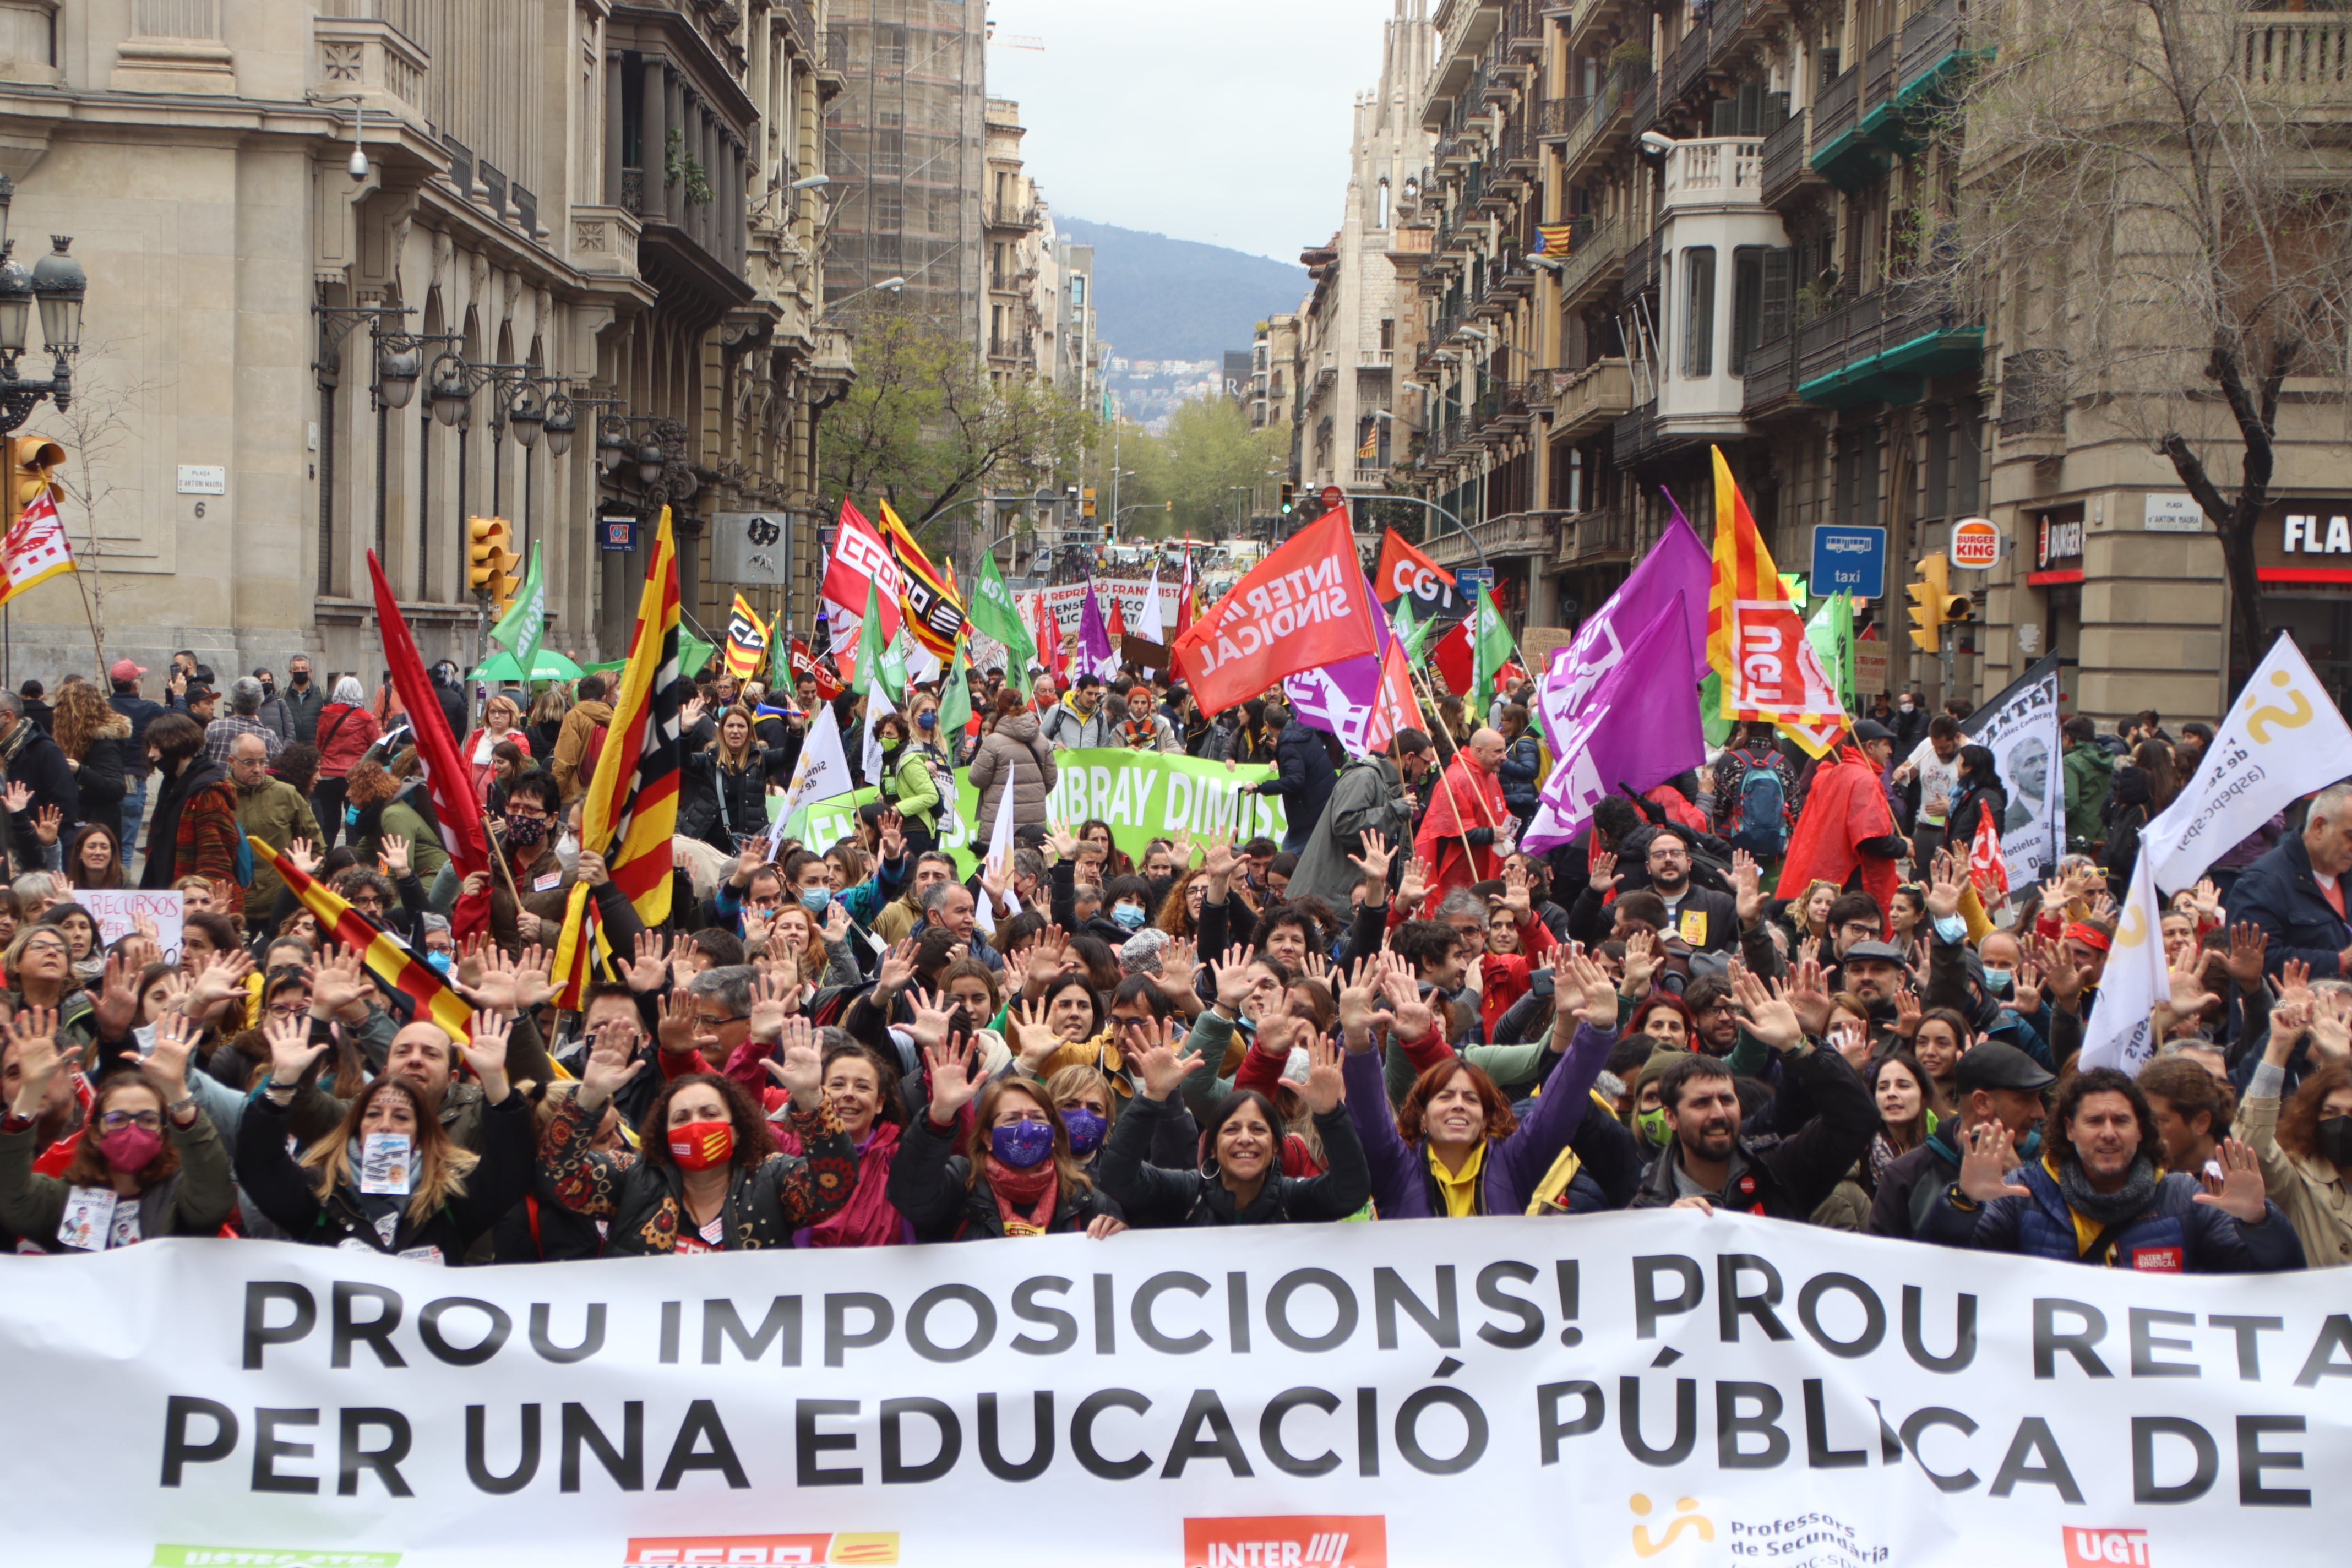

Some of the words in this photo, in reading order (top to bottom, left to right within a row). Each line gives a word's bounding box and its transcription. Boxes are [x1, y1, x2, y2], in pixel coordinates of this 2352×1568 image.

[194, 501, 206, 518] 6
[1957, 535, 1995, 544] BURGER
[2050, 521, 2082, 558] BURGER
[2284, 515, 2352, 553] FLA
[1956, 544, 1995, 557] KING
[1393, 559, 1453, 608] CGT
[1835, 570, 1860, 583] taxi
[1015, 592, 1047, 604] POU
[2019, 711, 2053, 728] Cambray
[90, 894, 178, 918] RECURSOS
[2138, 1260, 2177, 1268] SINDICAL
[242, 1281, 607, 1370] PROU
[658, 1259, 1580, 1377] IMPOSICIONS!
[1631, 1253, 1978, 1375] PROU
[159, 1395, 416, 1499] PER
[464, 1398, 752, 1496] UNA
[794, 1356, 1490, 1488] EDUCACIÓ
[1536, 1346, 2086, 1506] PÚBLICA
[2131, 1415, 2312, 1509] DE
[1730, 1512, 1856, 1539] Professors
[638, 1545, 813, 1565] CCOO
[1208, 1540, 1303, 1567] INTER
[1730, 1540, 1759, 1556] de
[1766, 1531, 1889, 1565] Secundària
[2076, 1532, 2148, 1566] UGT
